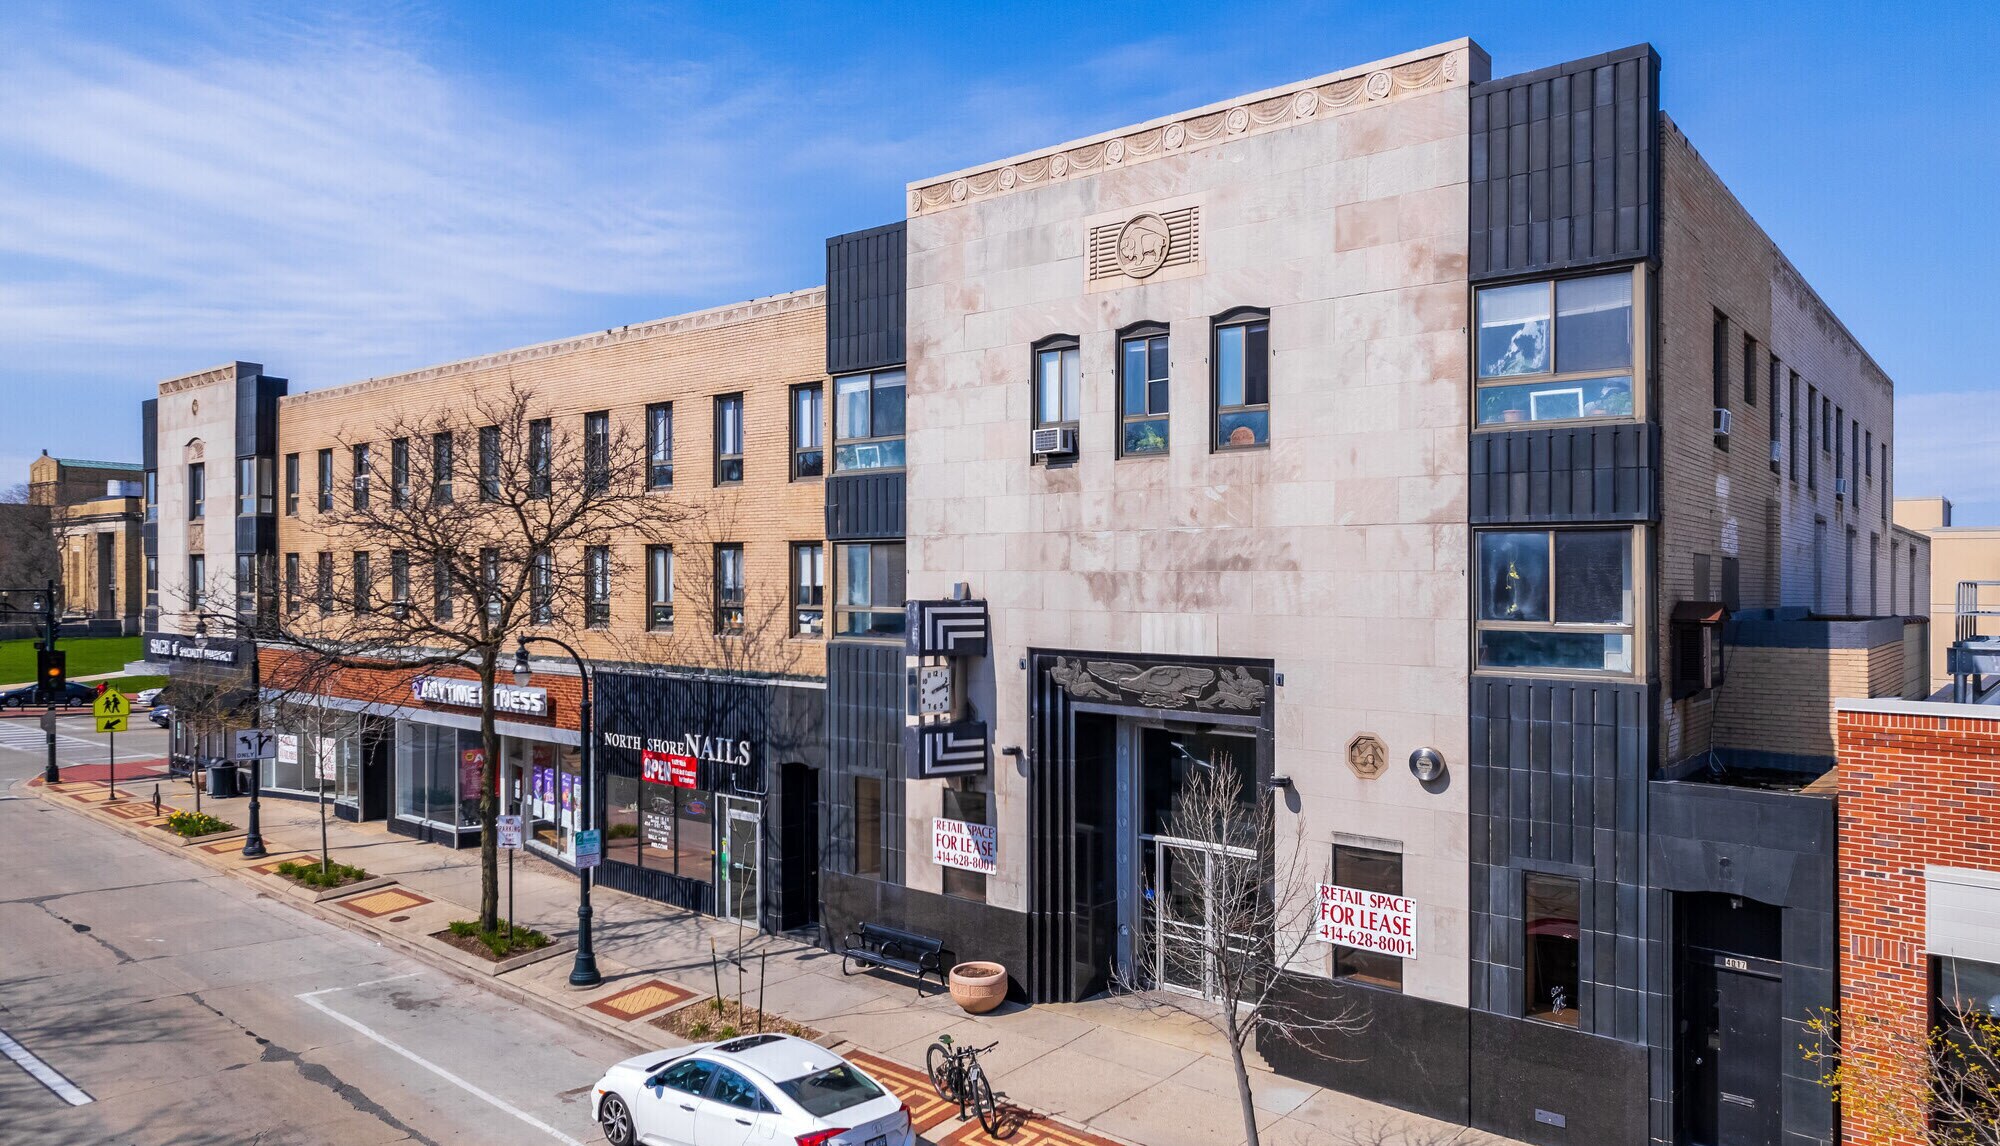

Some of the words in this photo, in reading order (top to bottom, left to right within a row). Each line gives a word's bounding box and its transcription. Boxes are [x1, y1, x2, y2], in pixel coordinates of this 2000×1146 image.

[604, 732, 642, 750] NORTH
[647, 738, 686, 756] SHORE
[684, 733, 751, 766] NAILS
[644, 757, 672, 782] OPEN
[499, 825, 521, 833] PARKING
[576, 833, 583, 845] 2
[936, 819, 964, 835] RETAIL
[966, 824, 995, 840] SPACE
[936, 833, 957, 850] FOR
[960, 837, 993, 857] LEASE
[936, 850, 994, 871] 414-628-8001
[1320, 885, 1366, 907] RETAIL
[1369, 893, 1412, 914] SPACE
[1321, 902, 1355, 927] FOR
[1360, 909, 1412, 937] LEASE
[1320, 924, 1412, 955] 414-628-8001
[1726, 959, 1746, 969] 4017
